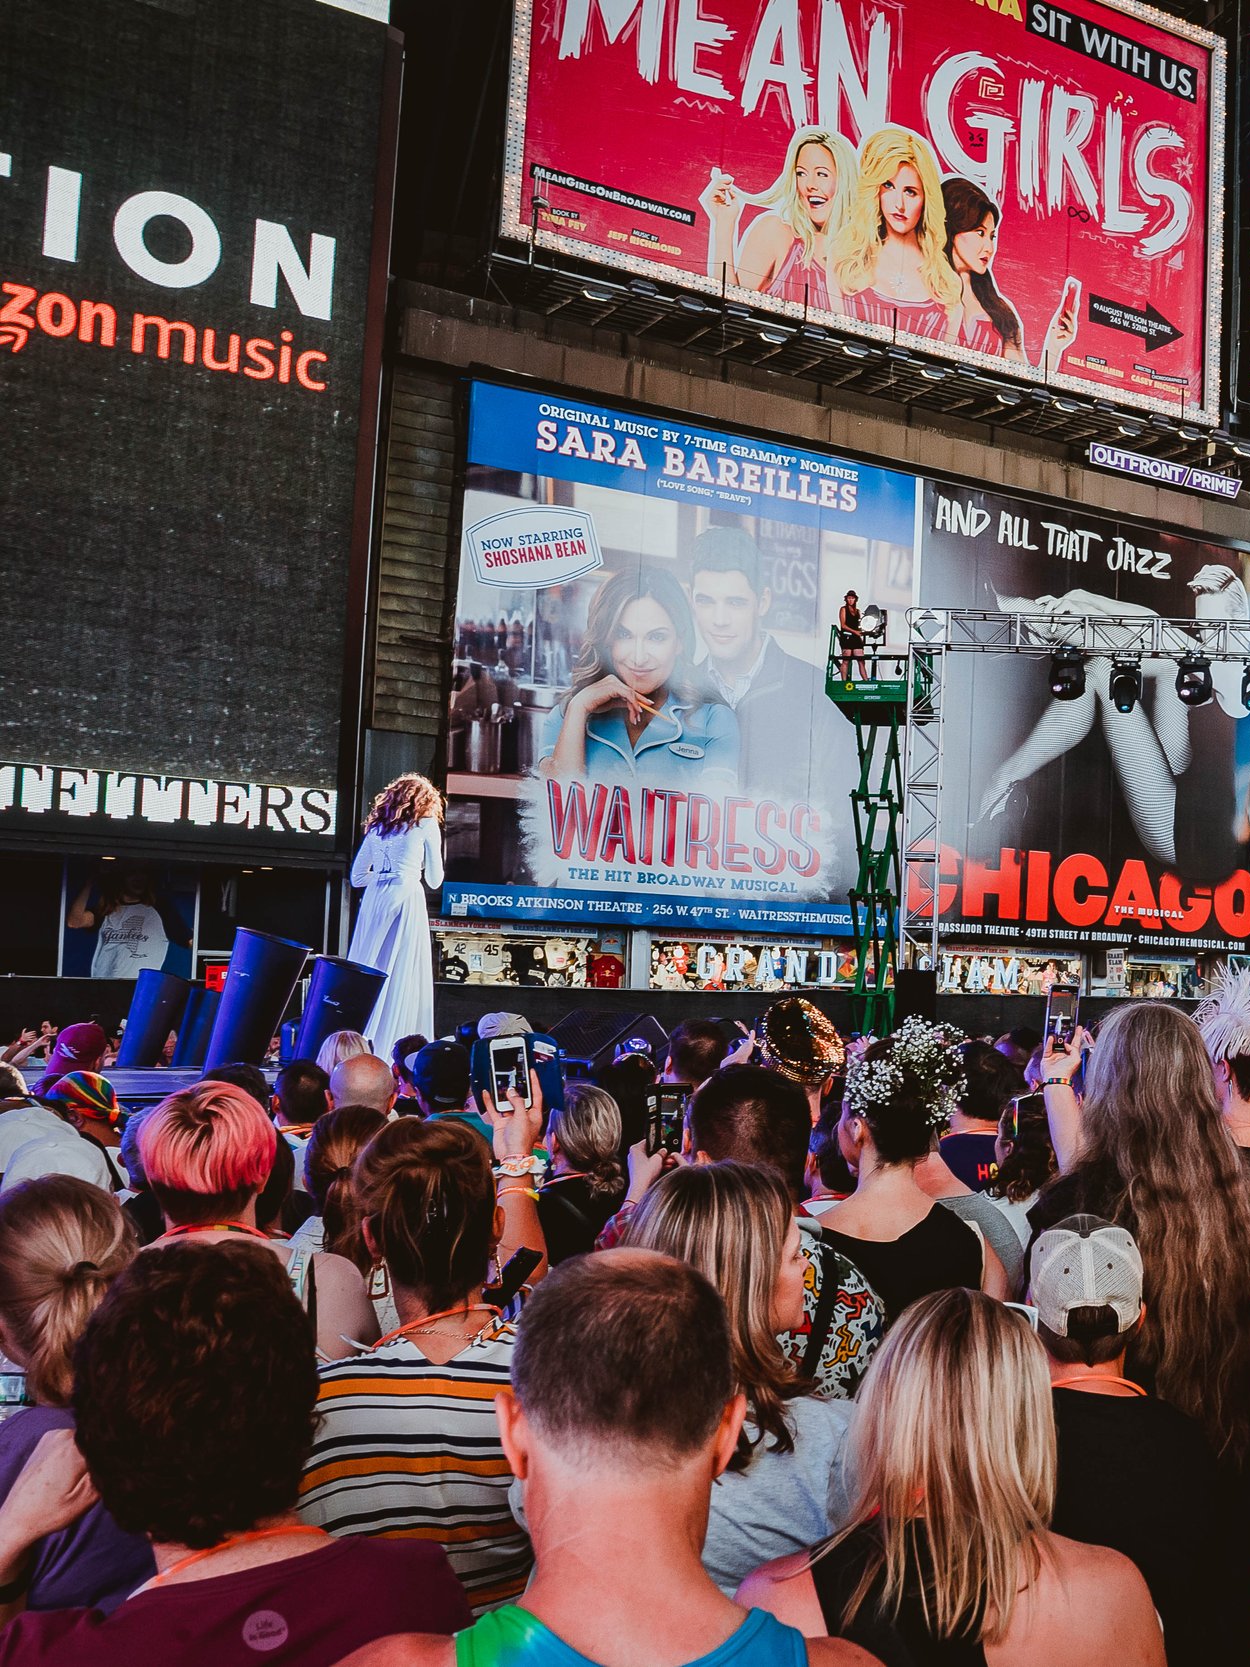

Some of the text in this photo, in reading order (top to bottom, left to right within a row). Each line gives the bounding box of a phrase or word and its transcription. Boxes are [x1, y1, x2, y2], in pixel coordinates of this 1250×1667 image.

[1032, 3, 1195, 99] SIT WITH US.
[558, 0, 892, 140] MEAN
[926, 51, 1192, 256] GIRLS
[552, 208, 570, 218] BOOK
[568, 219, 587, 232] FEY
[0, 152, 336, 321] ION
[607, 230, 682, 256] JEFF RICHMOND
[633, 229, 659, 242] MUSIC BY
[1099, 304, 1123, 318] AUGUST
[1124, 312, 1148, 326] WILSON
[1110, 316, 1122, 325] 245
[1123, 320, 1131, 328] W.
[1132, 322, 1148, 333] 52ND
[131, 313, 328, 391] music
[539, 403, 610, 429] ORIGINAL
[614, 419, 659, 439] MUSIC
[662, 430, 680, 443] BY
[684, 435, 727, 454] 7-TIME
[800, 459, 859, 482] NOMINEE
[536, 420, 858, 513] SARA BAREILLES
[1094, 446, 1237, 496] OUTFRONT PRIME
[481, 528, 583, 551] NOW STARRING
[935, 495, 1172, 580] AND ALL THAT JAZZ
[484, 540, 587, 568] SHOSHANA BEAN
[677, 746, 699, 755] Jenna
[547, 779, 821, 877] WAITRESS
[568, 867, 798, 894] THE HIT BROADWAY MUSICAL
[461, 894, 513, 907] BROOKS
[516, 896, 584, 910] ATKINSON
[587, 898, 643, 913] THEATRE
[653, 904, 673, 915] 256
[716, 909, 730, 919] ST.
[1114, 906, 1184, 919] THE MUSICAL
[454, 943, 466, 955] 42
[484, 944, 499, 956] 45
[926, 922, 1246, 951] BASSADOR THEATRE 49TH STREET AT BROADWAY CHICAGOTHEMUSICAL.COM
[697, 945, 838, 984] GRAND
